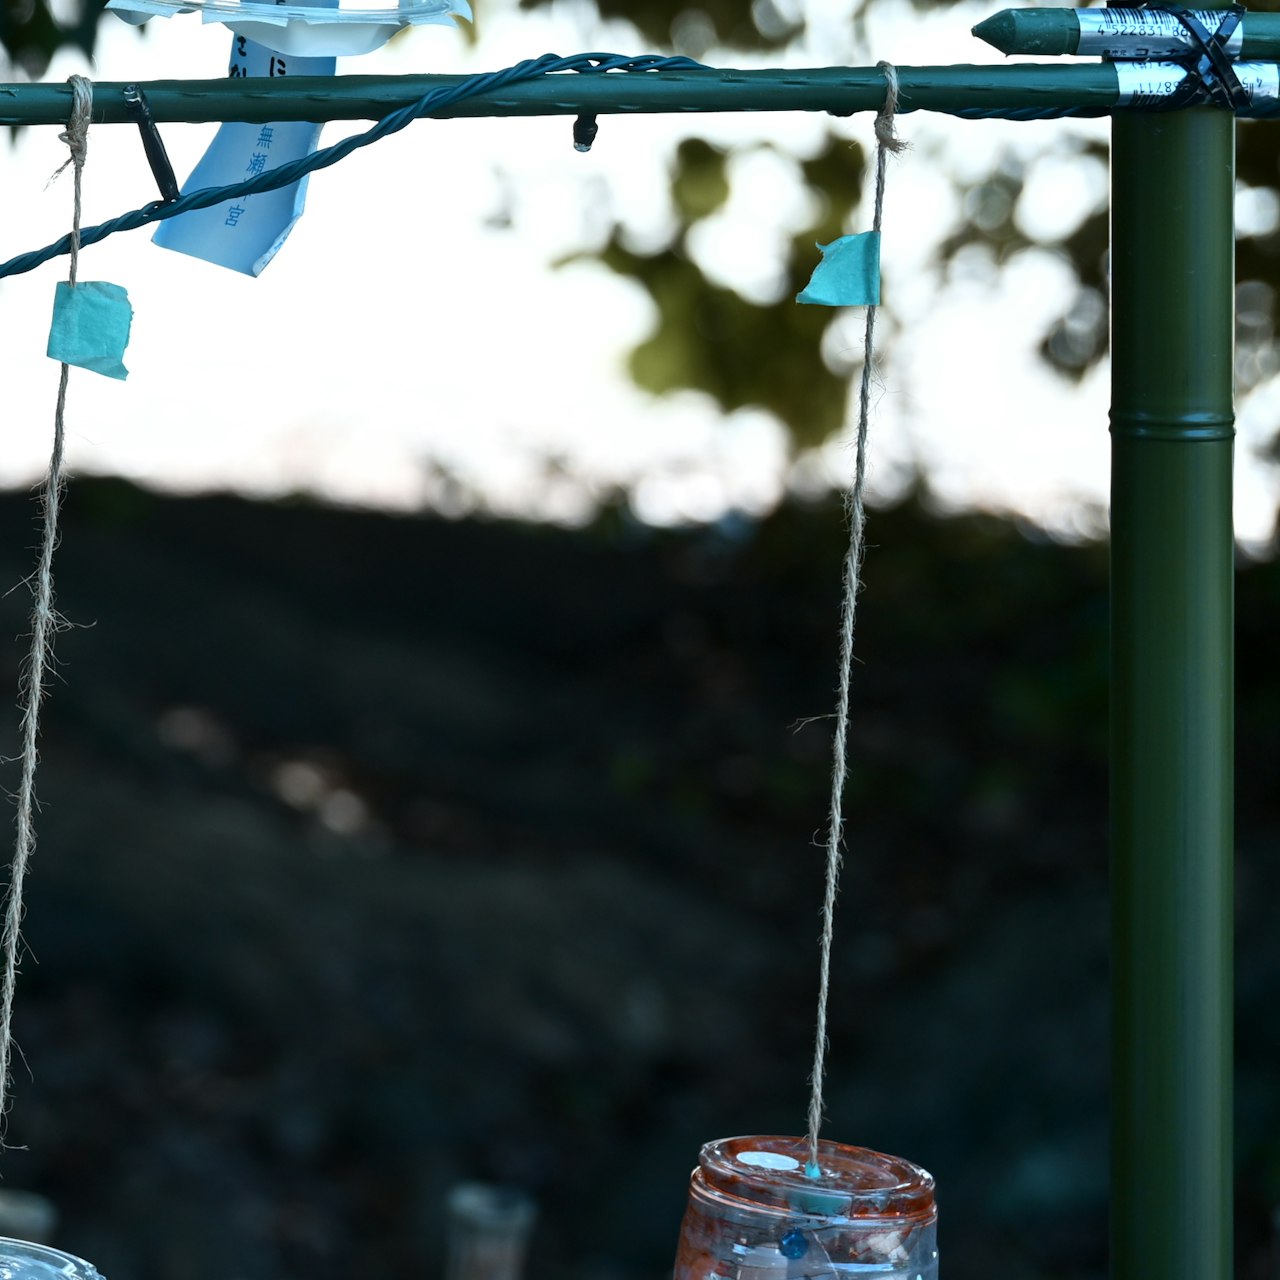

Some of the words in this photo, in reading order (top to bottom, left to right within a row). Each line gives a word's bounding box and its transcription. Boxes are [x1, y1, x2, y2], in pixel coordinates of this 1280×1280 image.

[1097, 24, 1105, 36] 4
[1111, 24, 1163, 36] 522831
[1139, 81, 1179, 94] 8711
[224, 125, 274, 227] 無瀬宮
